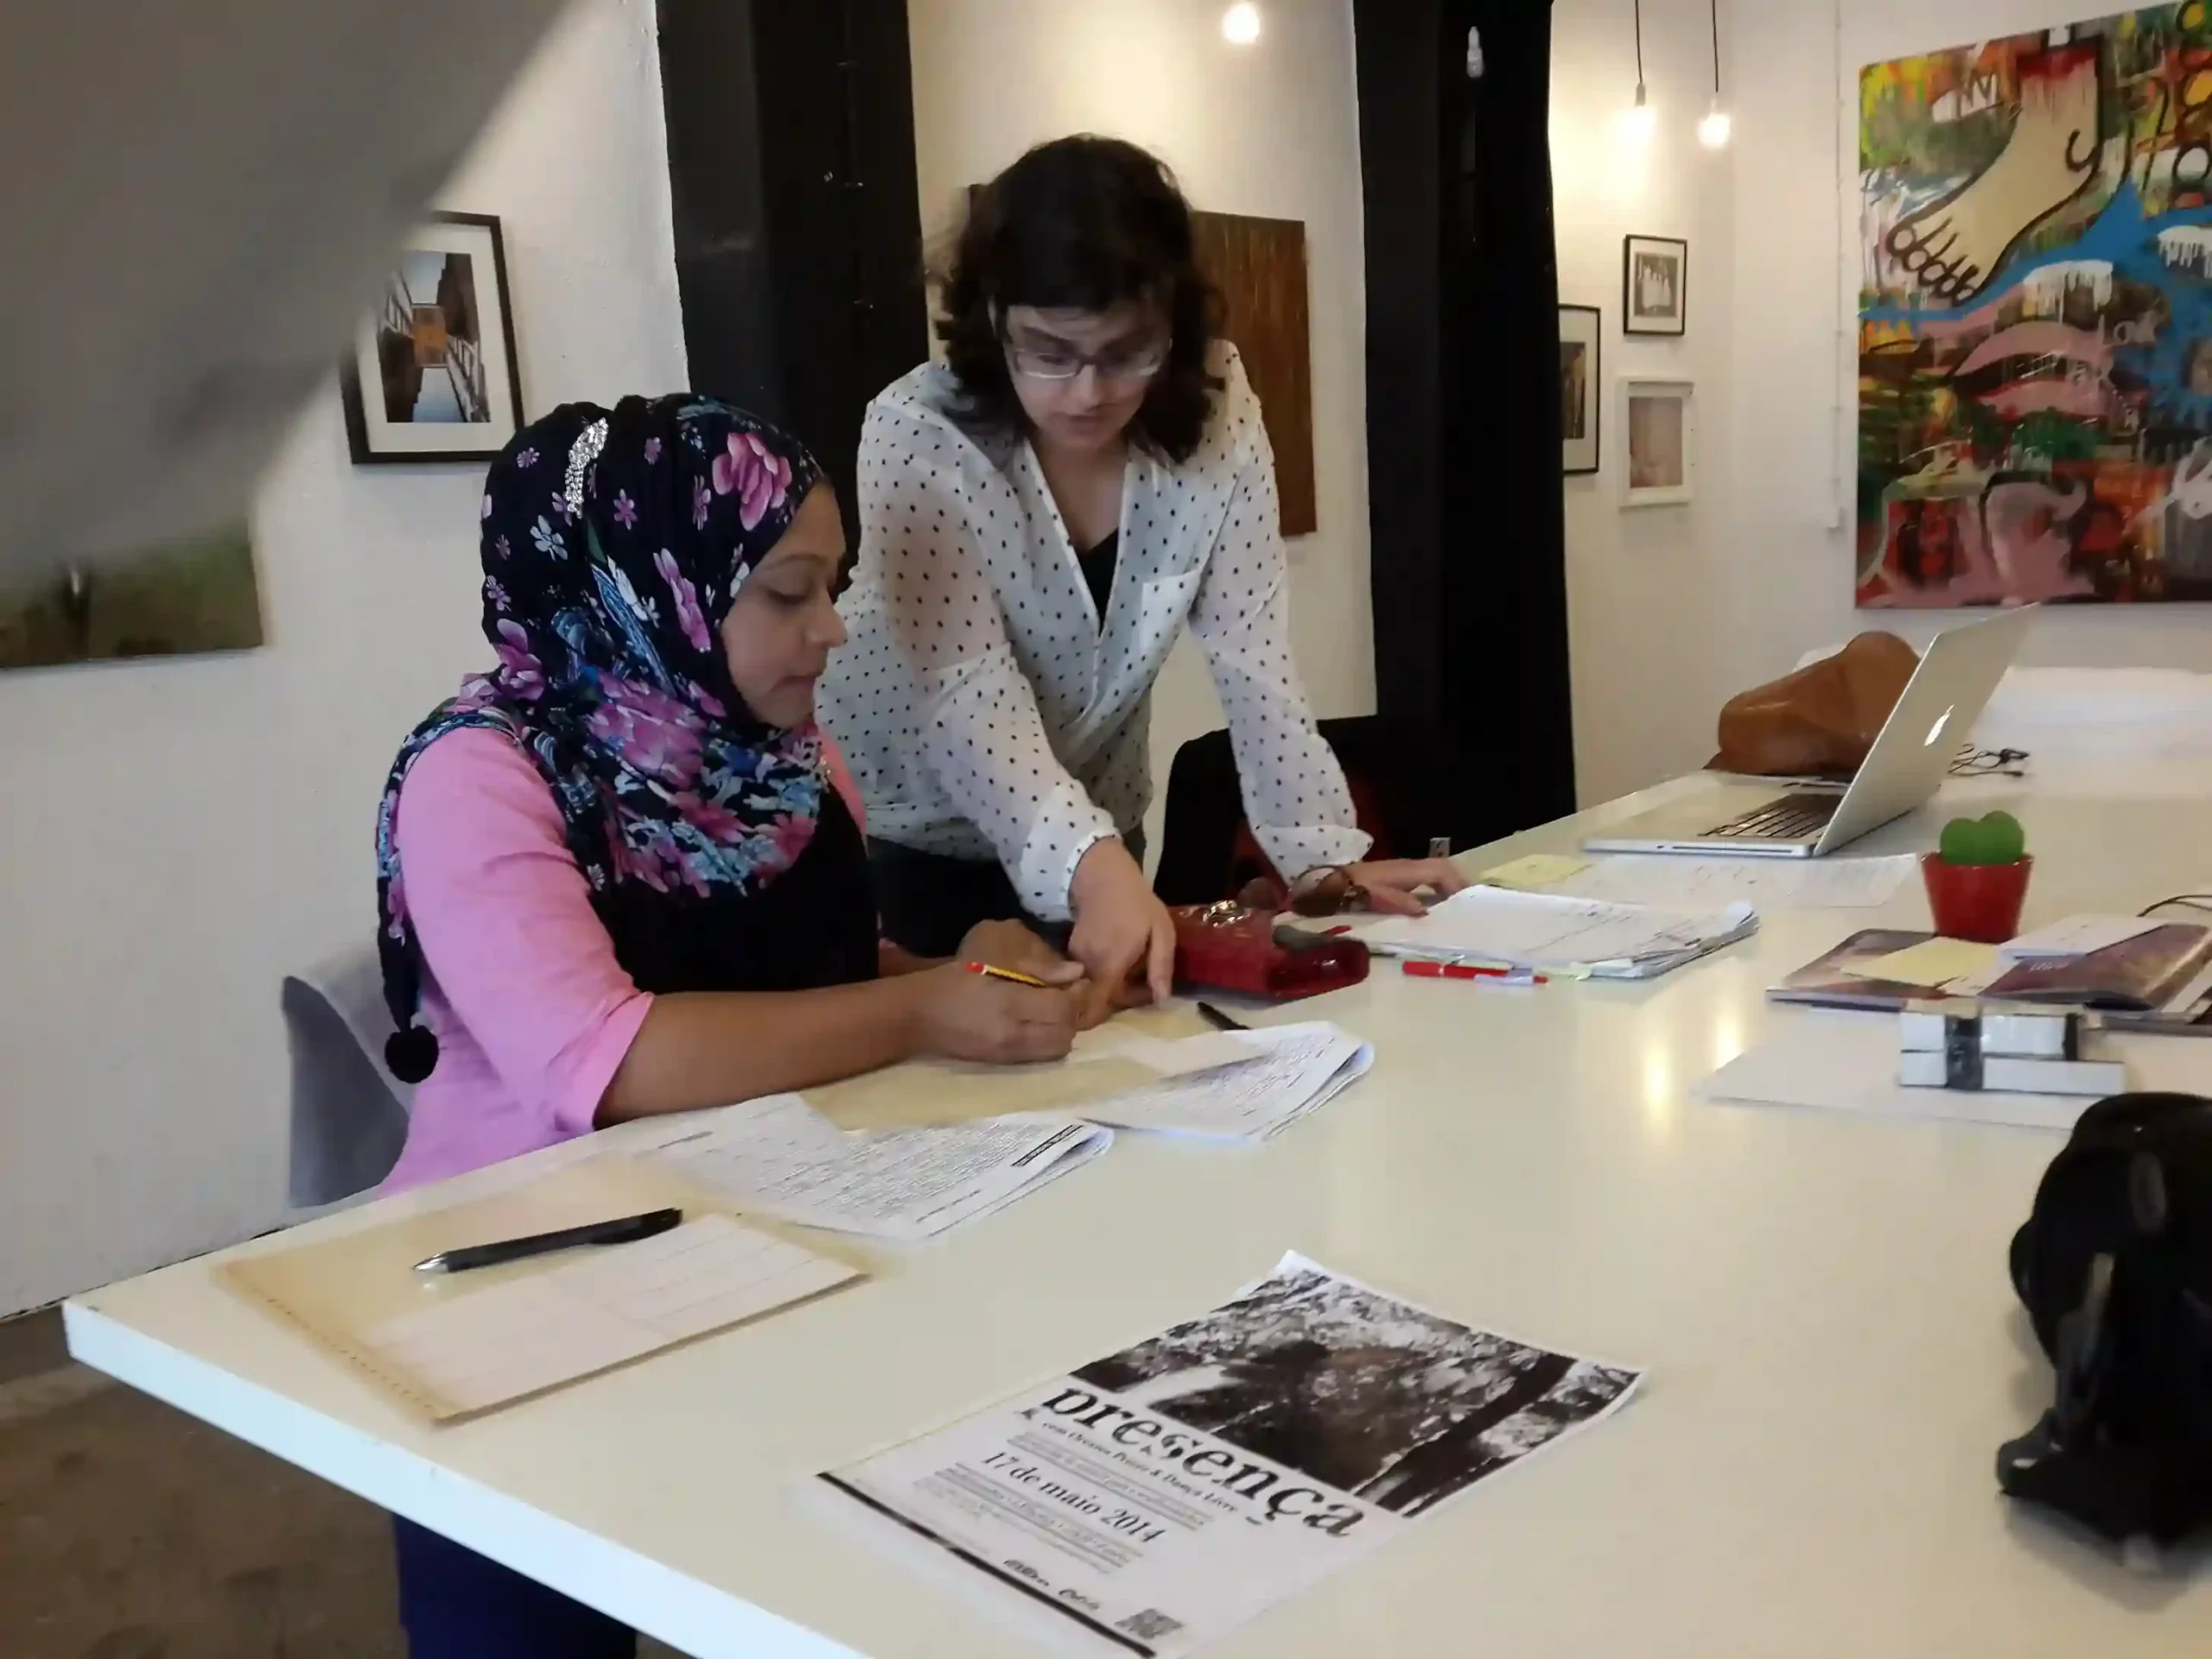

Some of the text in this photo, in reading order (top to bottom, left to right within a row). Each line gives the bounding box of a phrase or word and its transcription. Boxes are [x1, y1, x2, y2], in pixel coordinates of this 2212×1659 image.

[982, 1452, 1166, 1542] 17 de maio 2014
[1022, 1388, 1364, 1538] presença
